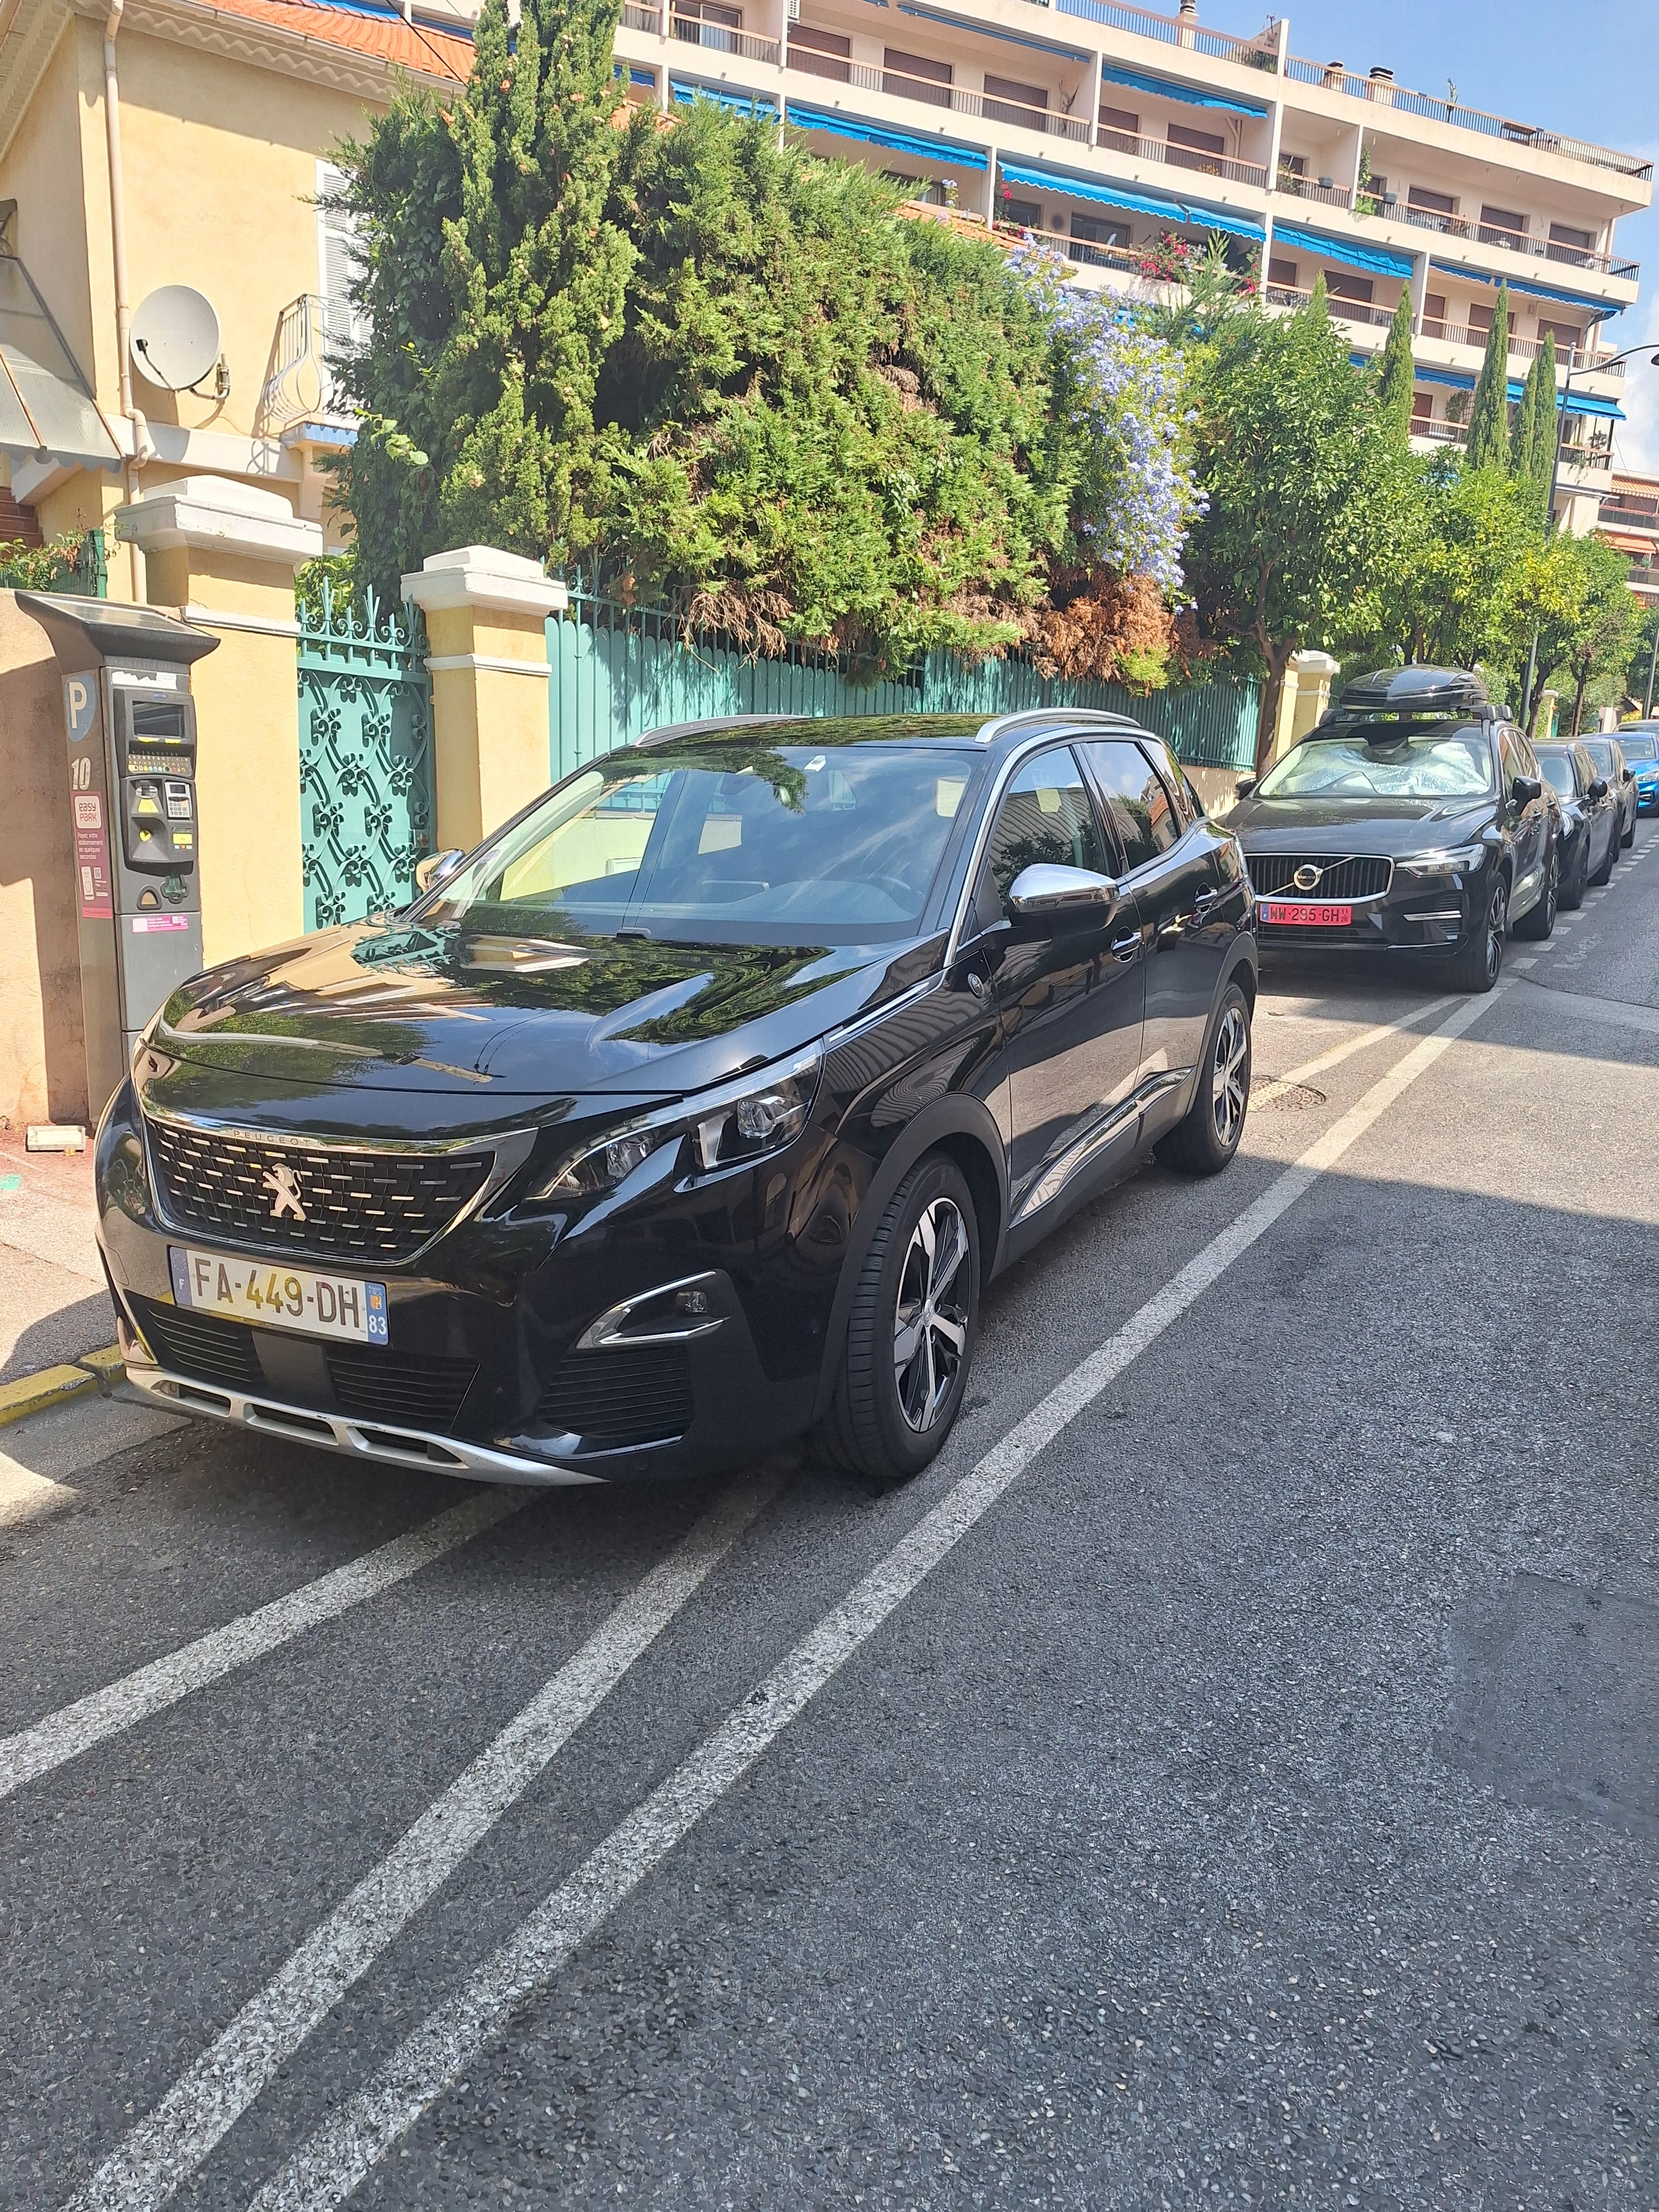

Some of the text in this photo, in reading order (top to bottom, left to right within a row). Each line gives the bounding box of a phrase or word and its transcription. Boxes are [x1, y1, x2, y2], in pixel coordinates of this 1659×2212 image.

[69, 682, 87, 729] P
[71, 757, 91, 790] 10
[79, 803, 96, 812] easy
[234, 1130, 311, 1147] PEUGEOT
[179, 1278, 184, 1289] F
[195, 1258, 359, 1328] FA-449-DH
[369, 1315, 387, 1335] 83
